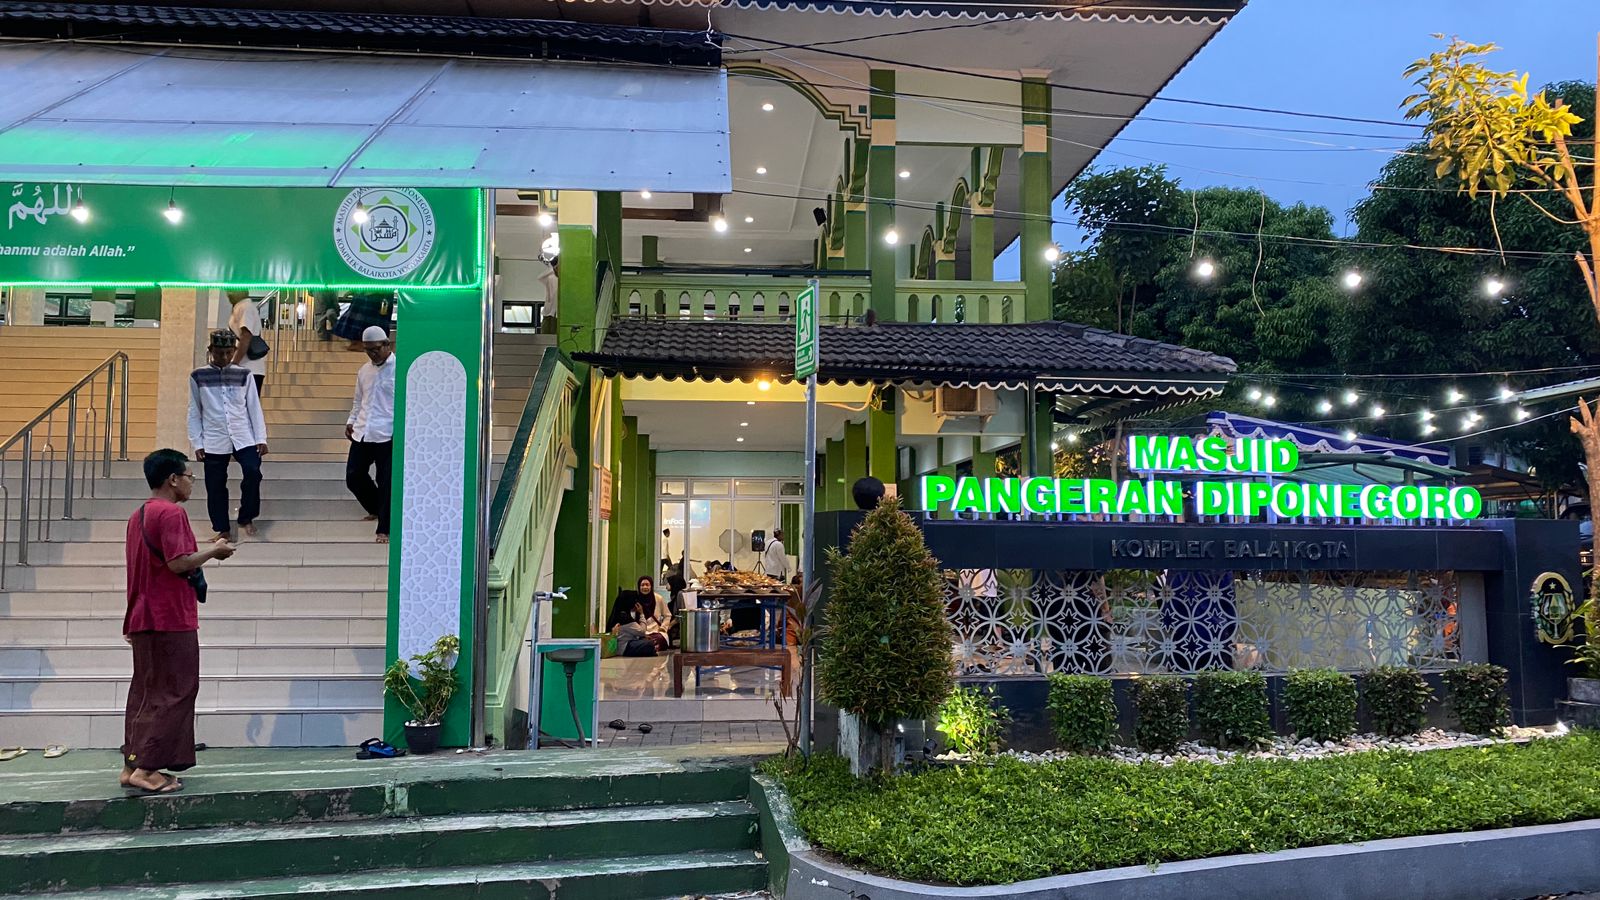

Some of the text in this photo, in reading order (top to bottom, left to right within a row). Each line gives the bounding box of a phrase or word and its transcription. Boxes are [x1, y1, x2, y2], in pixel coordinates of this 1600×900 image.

[337, 197, 353, 225] MASJID
[43, 245, 86, 257] adalah
[336, 238, 432, 279] KOMPLEK BALAIKOTA YOGYAKARTA
[1129, 435, 1299, 474] MASJID
[922, 475, 1482, 519] PANGERAN DIPONEGORO
[1111, 538, 1351, 561] KOMPLEK BALAIKOTA
